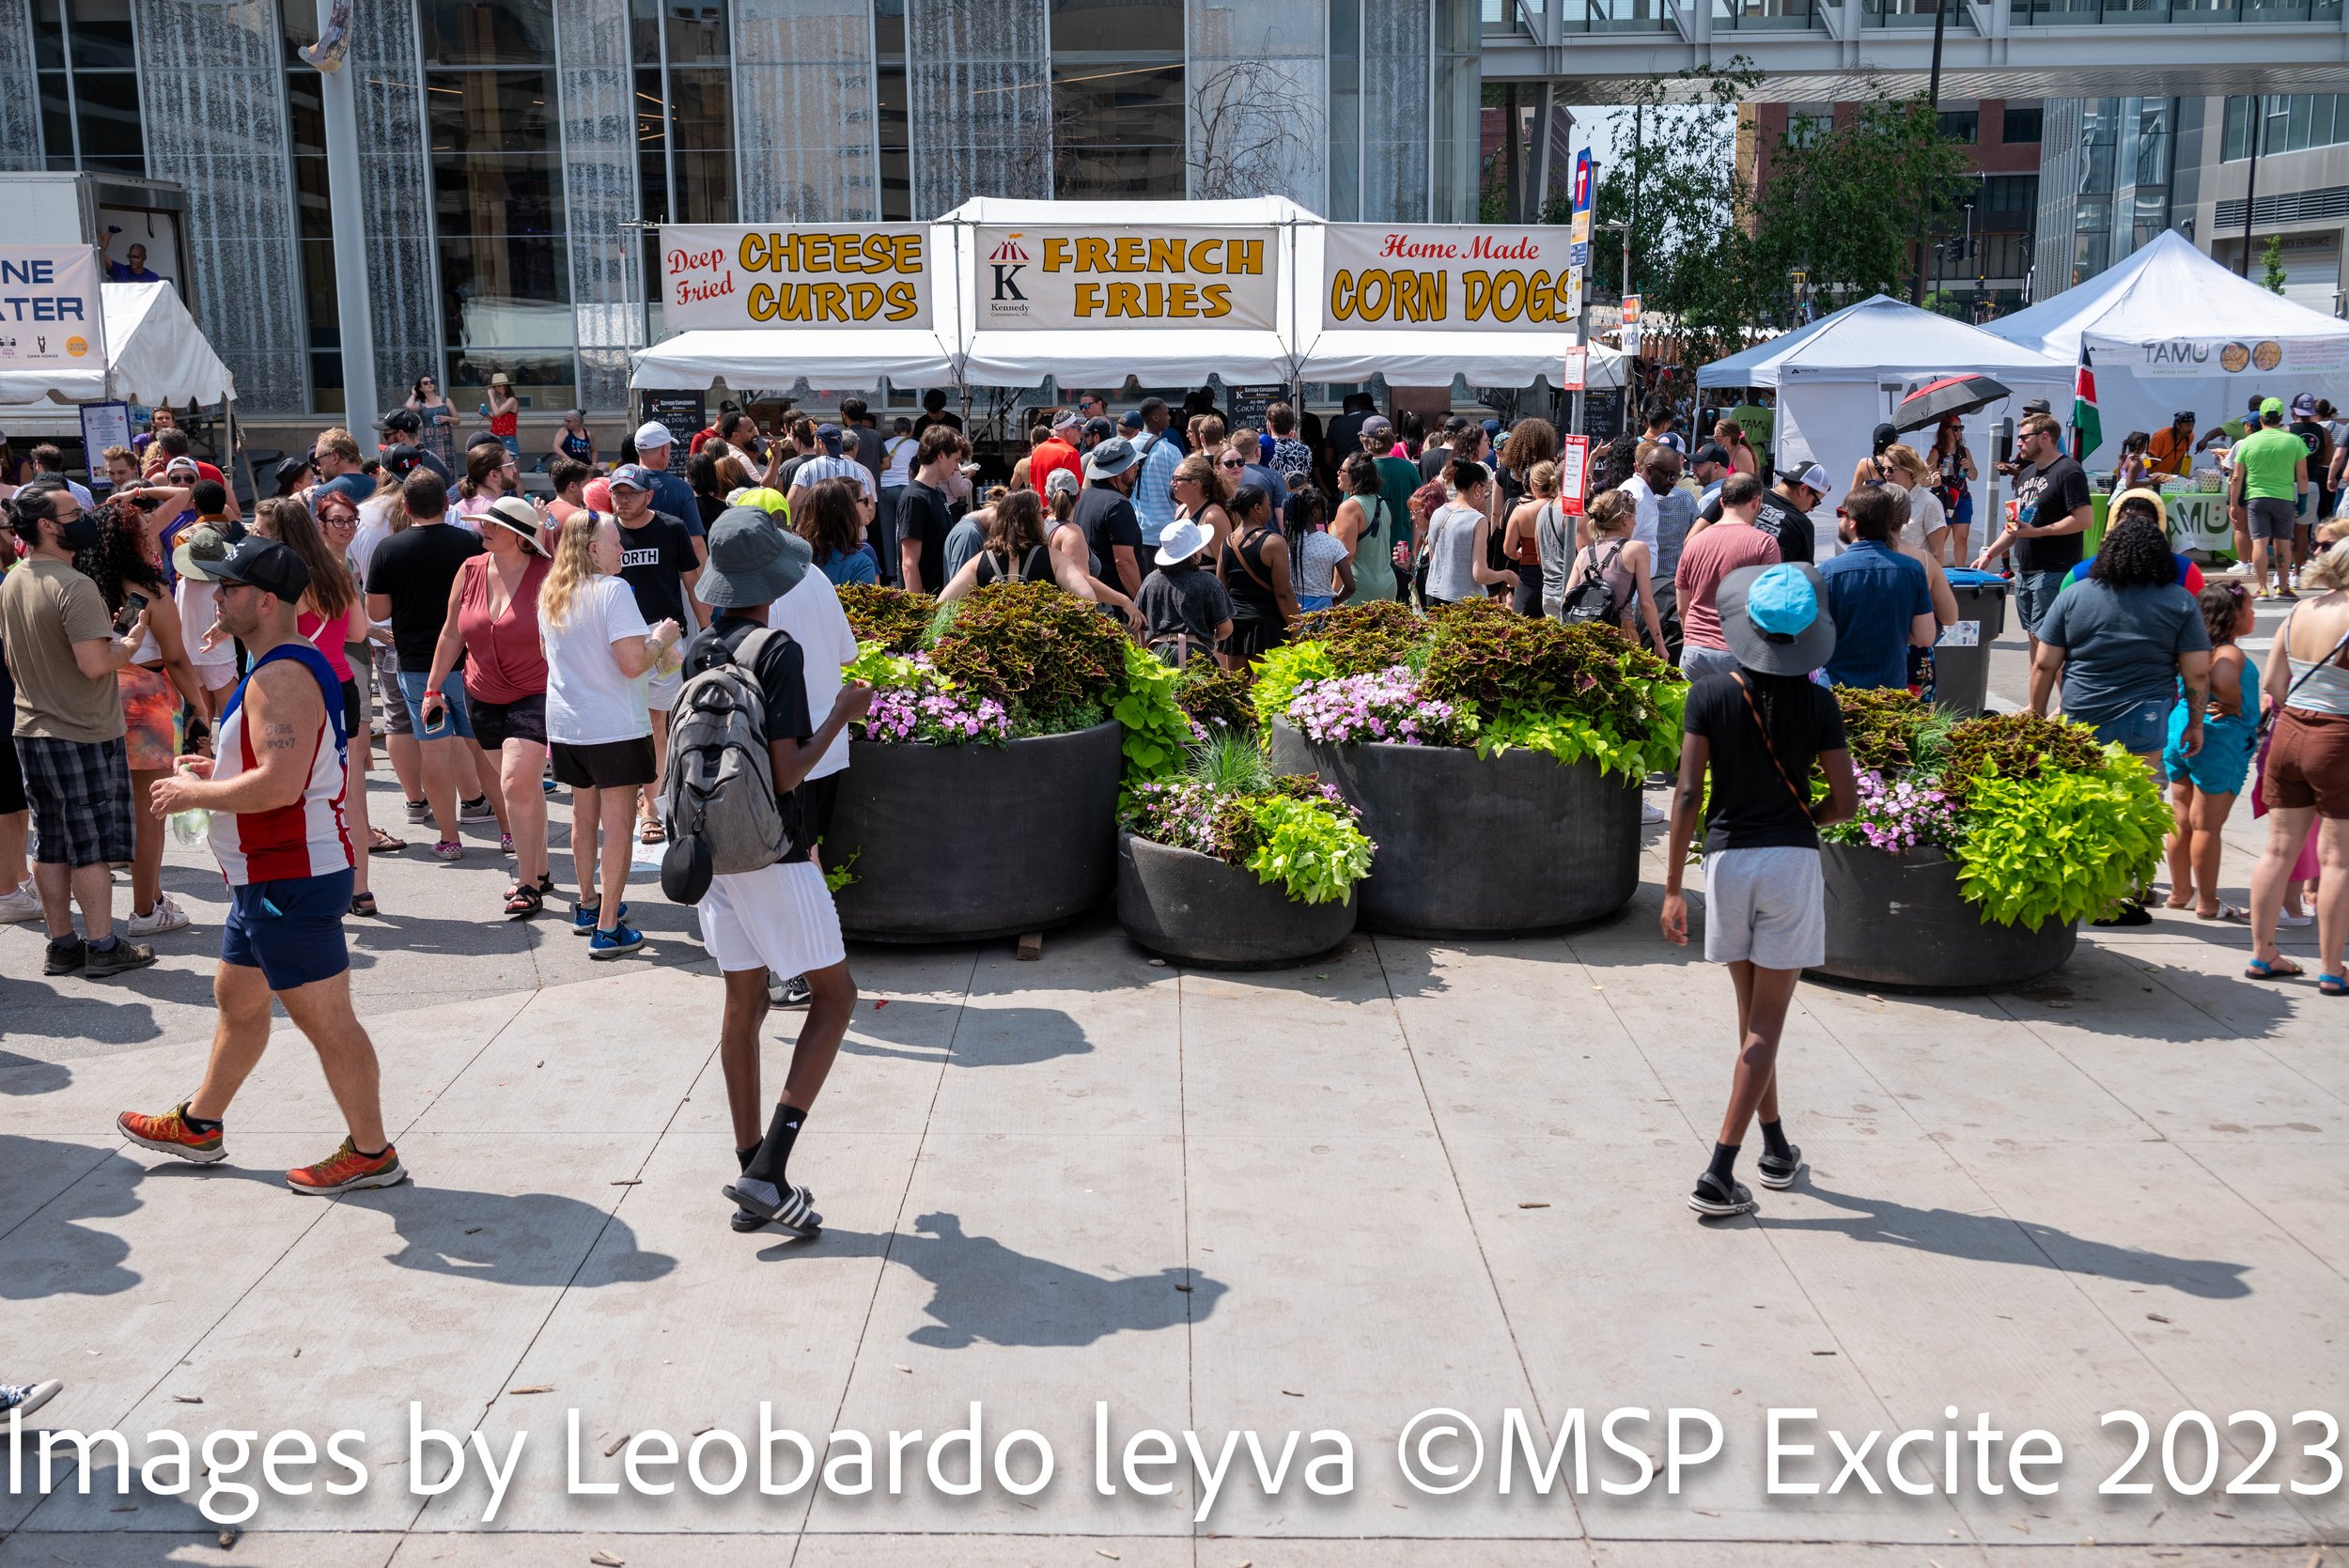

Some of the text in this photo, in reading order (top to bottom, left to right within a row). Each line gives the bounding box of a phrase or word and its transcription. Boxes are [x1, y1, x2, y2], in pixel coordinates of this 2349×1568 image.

[739, 232, 923, 273] CHEESE
[1042, 237, 1265, 274] FRENCH
[1379, 233, 1458, 258] Home
[1461, 235, 1540, 260] Made
[1, 260, 54, 284] NE
[667, 247, 727, 275] Deep
[676, 270, 736, 305] Fried
[990, 264, 1029, 301] K
[1330, 269, 1448, 323] CORN
[747, 281, 919, 322] CURDS
[991, 303, 1030, 313] Kennedy
[1073, 281, 1233, 318] FRIES
[1624, 332, 1639, 346] VISA
[2142, 343, 2209, 364] TAMU
[1236, 391, 1244, 399] K
[1740, 419, 1767, 429] TAMU
